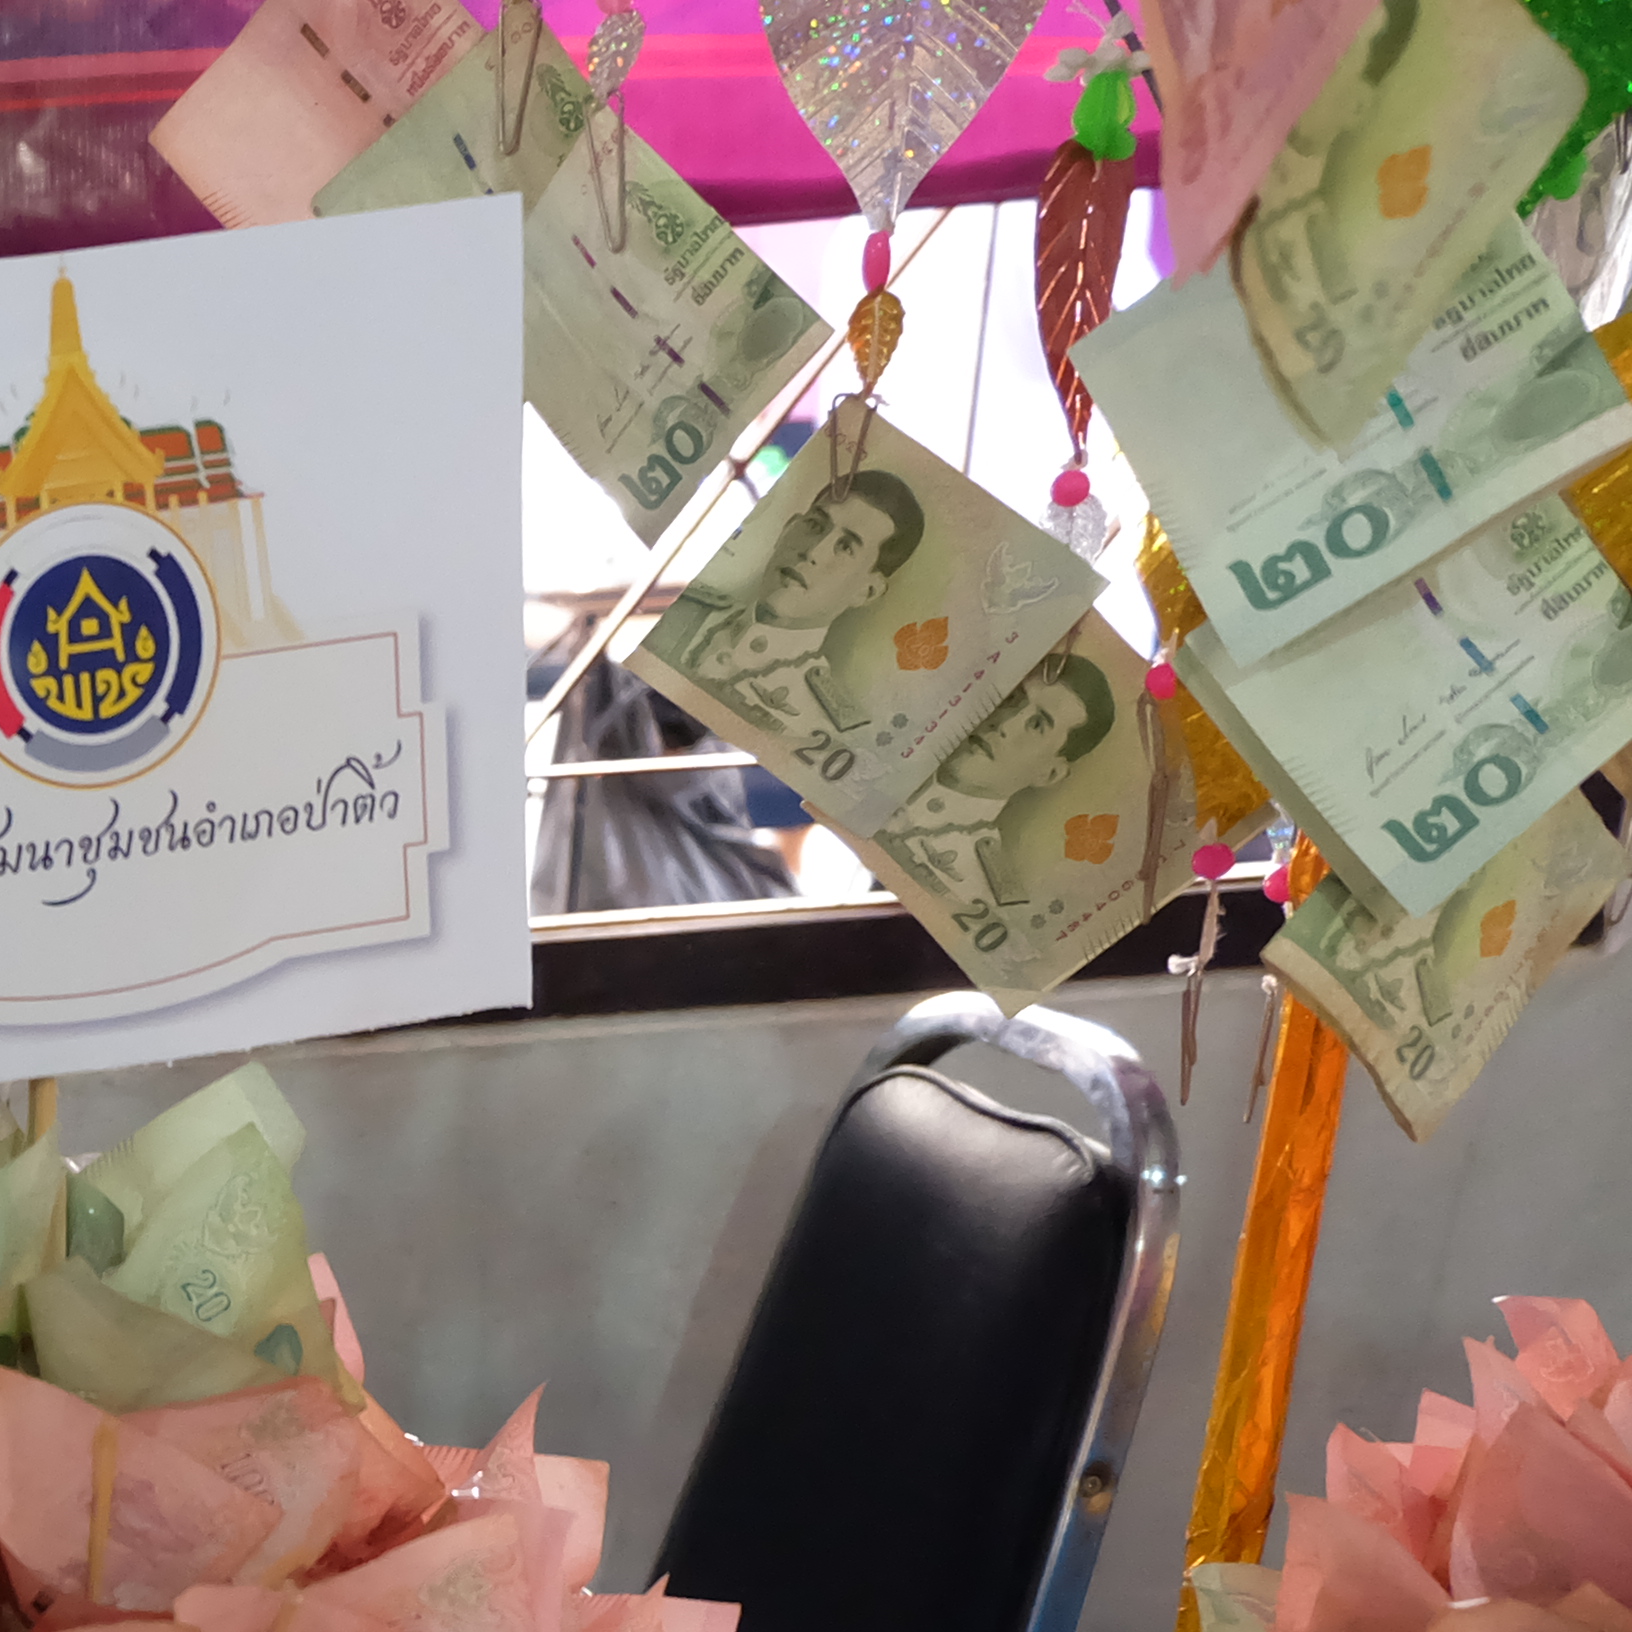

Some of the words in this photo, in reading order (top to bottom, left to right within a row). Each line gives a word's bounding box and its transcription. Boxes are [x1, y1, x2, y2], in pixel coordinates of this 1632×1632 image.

[617, 419, 708, 513] ๒๐
[1228, 496, 1391, 613] ๒๐
[794, 728, 857, 785] 20
[1381, 749, 1526, 865] ๒๐
[950, 899, 1011, 955] 20
[1394, 1023, 1437, 1081] 20
[181, 1266, 232, 1325] 20
